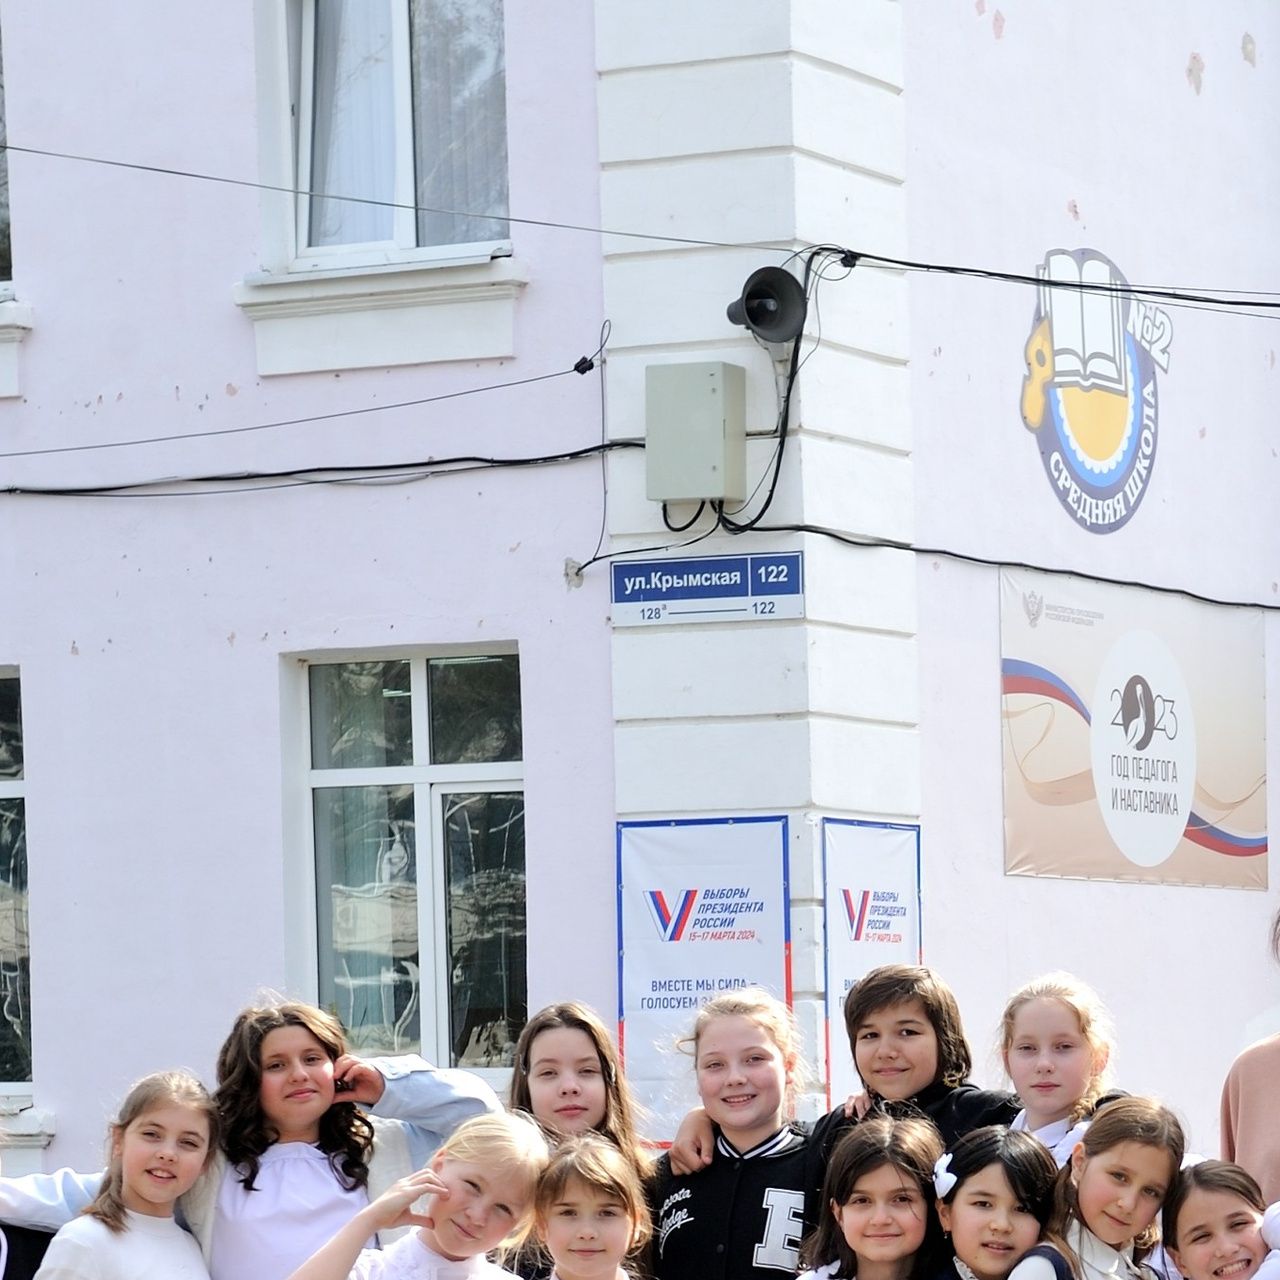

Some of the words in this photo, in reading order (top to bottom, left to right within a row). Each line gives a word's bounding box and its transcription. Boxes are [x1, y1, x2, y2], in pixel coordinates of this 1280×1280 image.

[1050, 451, 1127, 525] СРЕДНЯЯ
[1127, 380, 1156, 506] ШКОЛА
[624, 571, 741, 594] ул.Крымская
[757, 565, 788, 583] 122
[752, 602, 775, 615] 122
[1111, 755, 1129, 781] ГОД
[1132, 757, 1178, 783] ПЕДАГОГА
[1111, 787, 1118, 811] И
[1120, 788, 1179, 816] НАСТАВНИКА
[703, 888, 750, 900] ВЫБОРЫ
[872, 891, 899, 902] ВЫБОРЫ
[697, 902, 764, 914] ПРЕЗИДЕНТА
[870, 905, 907, 917] ПРЕЗИДЕНТА
[692, 918, 735, 929] РОССИИ
[867, 919, 891, 930] РОССИИ
[710, 931, 736, 940] МАРТА
[736, 930, 756, 940] 2024
[651, 980, 693, 992] ВМЕСТЕ
[696, 980, 714, 991] МЫ
[718, 979, 747, 990] СИЛА
[640, 997, 698, 1009] ГОЛОСУЕМ
[659, 1187, 692, 1217] esota
